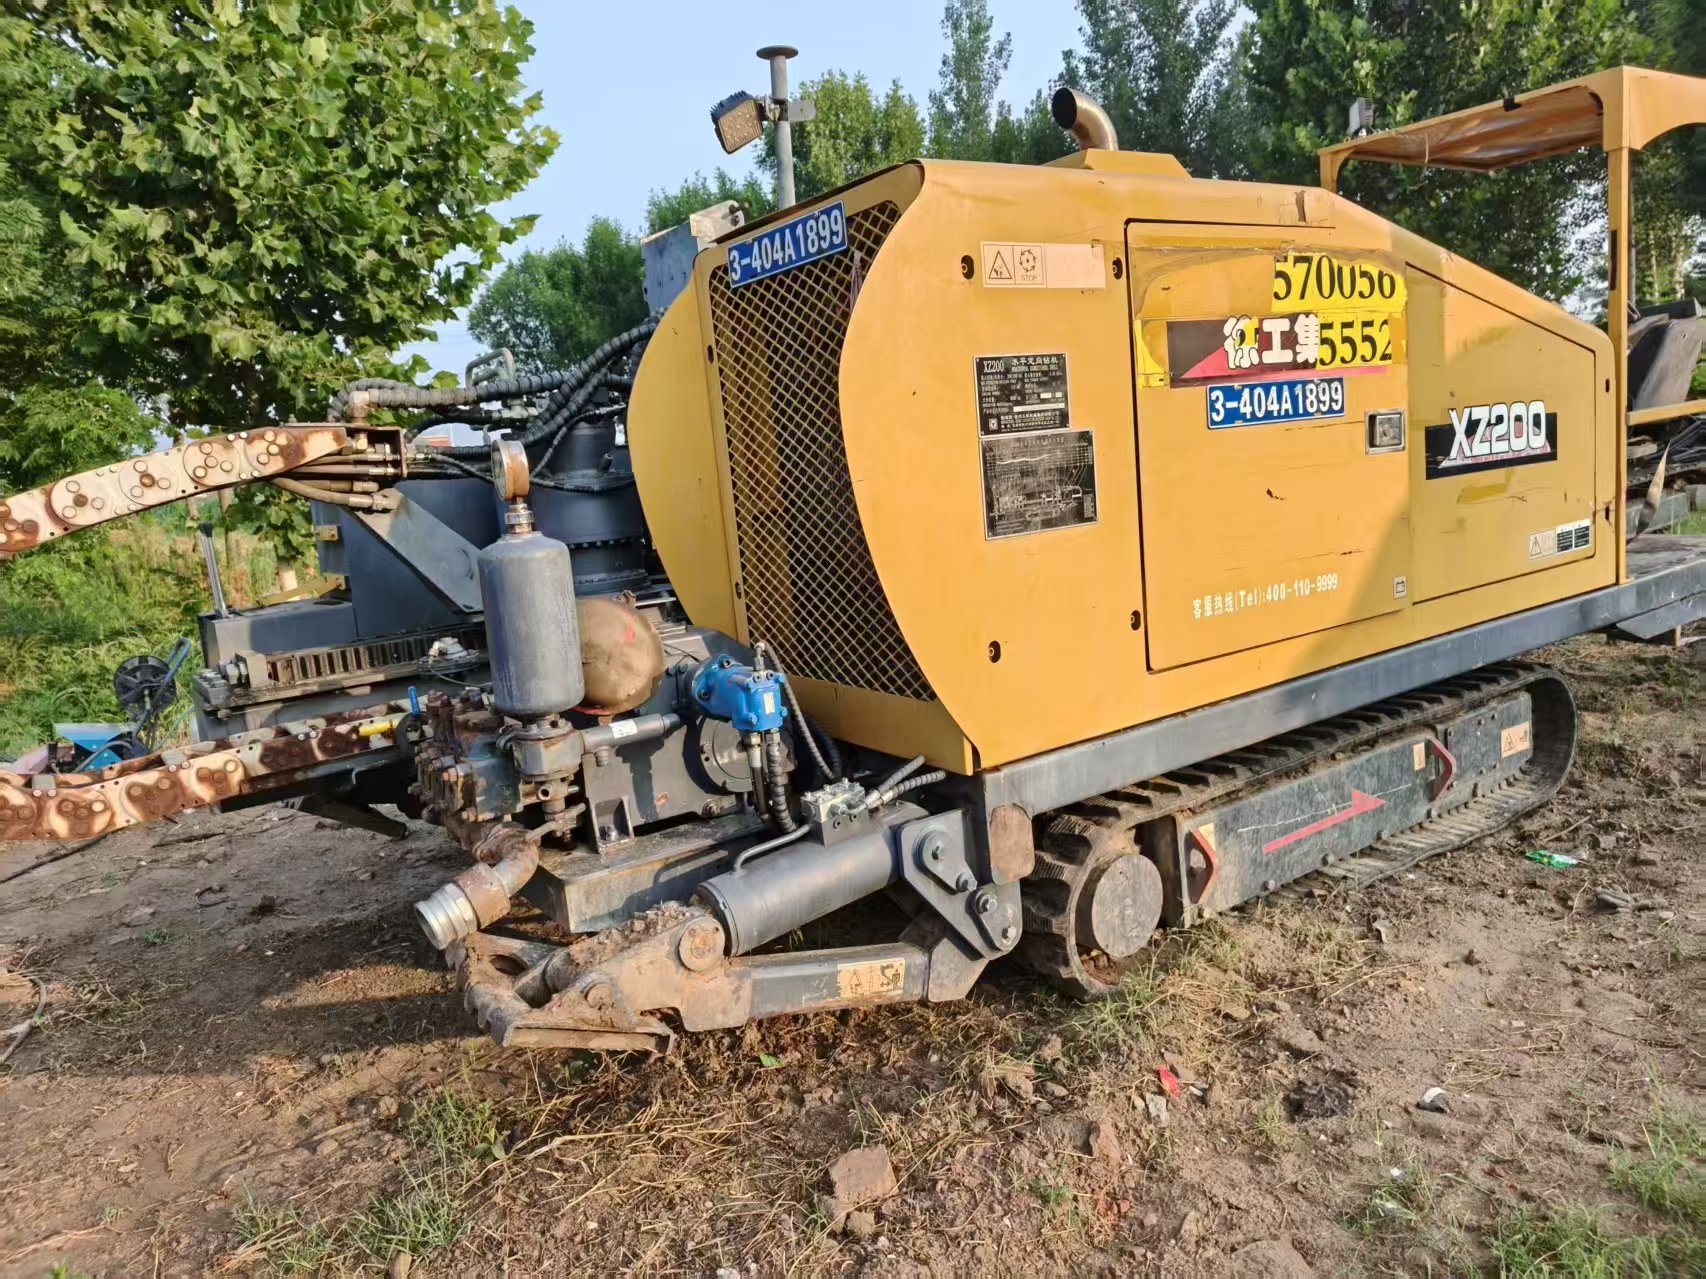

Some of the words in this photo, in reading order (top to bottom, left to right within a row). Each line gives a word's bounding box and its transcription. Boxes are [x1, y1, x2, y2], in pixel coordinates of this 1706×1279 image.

[729, 208, 843, 282] 3-404A1899
[1020, 274, 1038, 282] STOP
[983, 360, 1005, 373] XZ200
[1011, 356, 1059, 366] 水平定向钻机
[1209, 381, 1343, 422] 3-404A1899
[1449, 400, 1547, 461] XZ200
